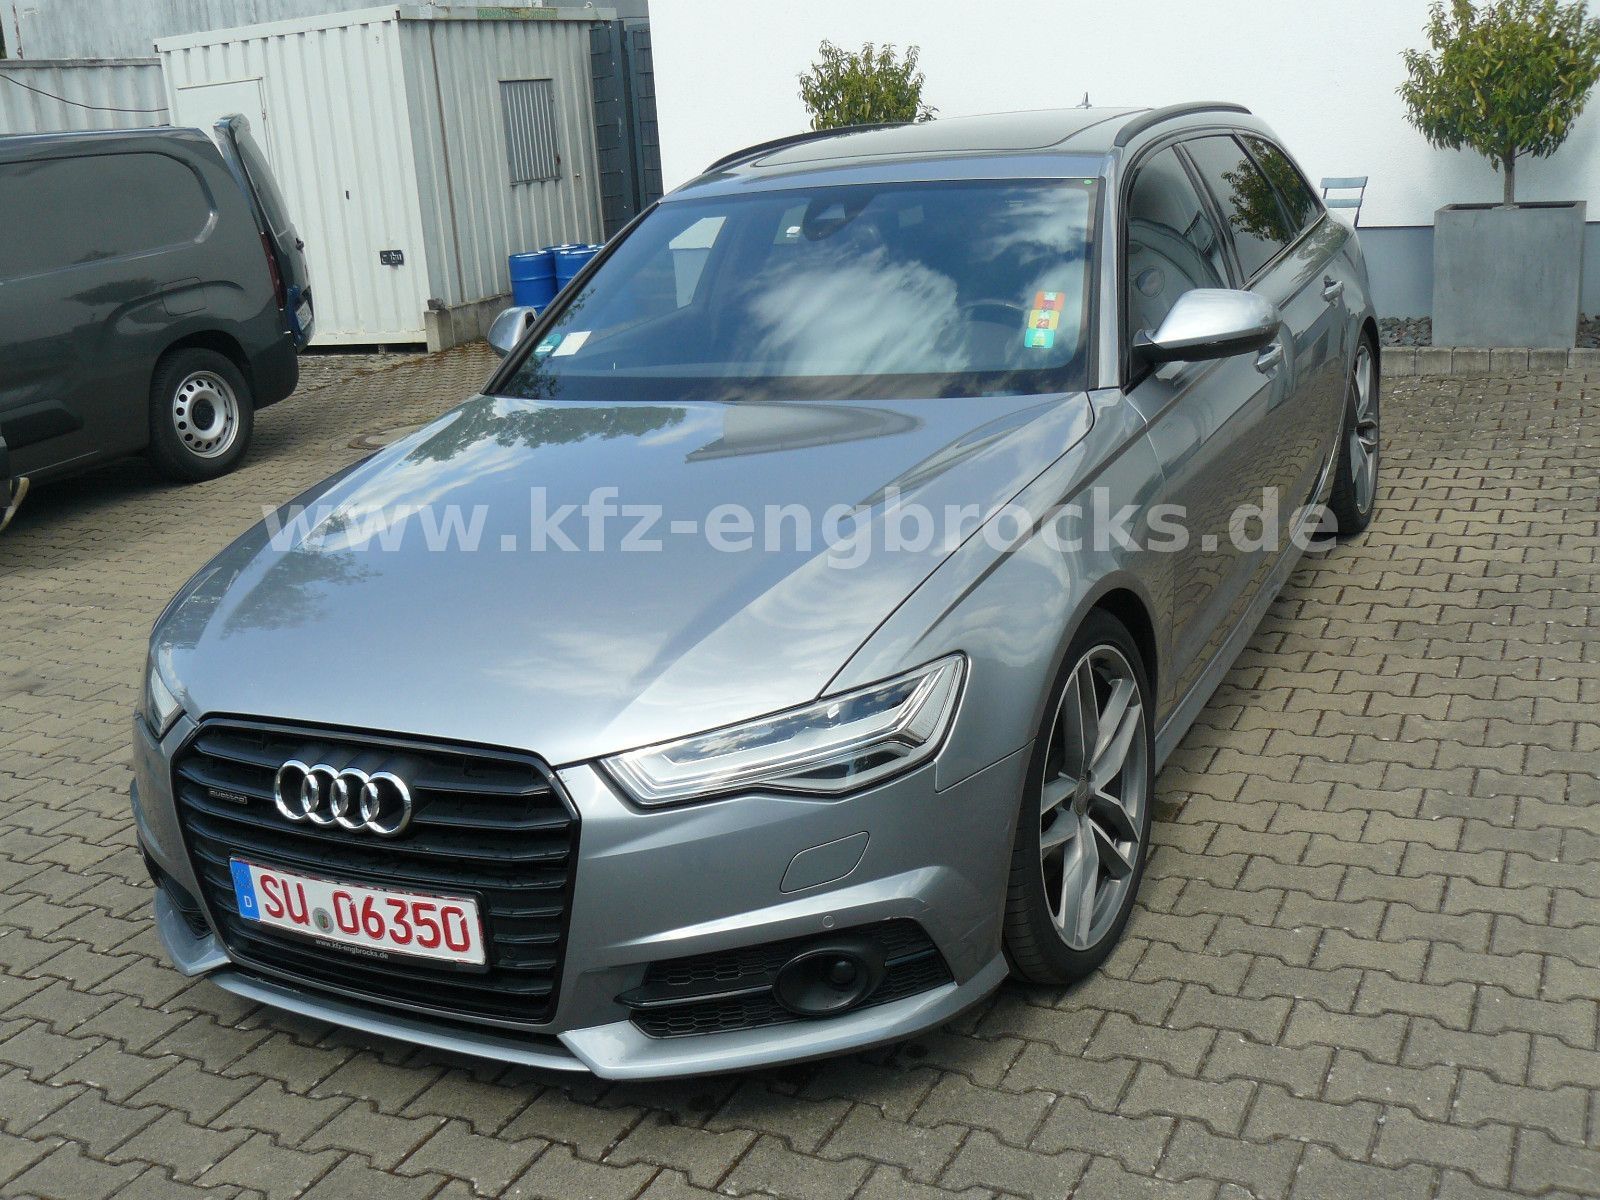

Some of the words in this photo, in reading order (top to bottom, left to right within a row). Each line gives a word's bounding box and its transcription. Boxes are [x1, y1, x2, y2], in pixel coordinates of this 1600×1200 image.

[244, 895, 252, 908] D
[260, 874, 310, 926] SU
[331, 889, 471, 953] 06350
[315, 938, 389, 960] www.kfz-engbrocks.de
